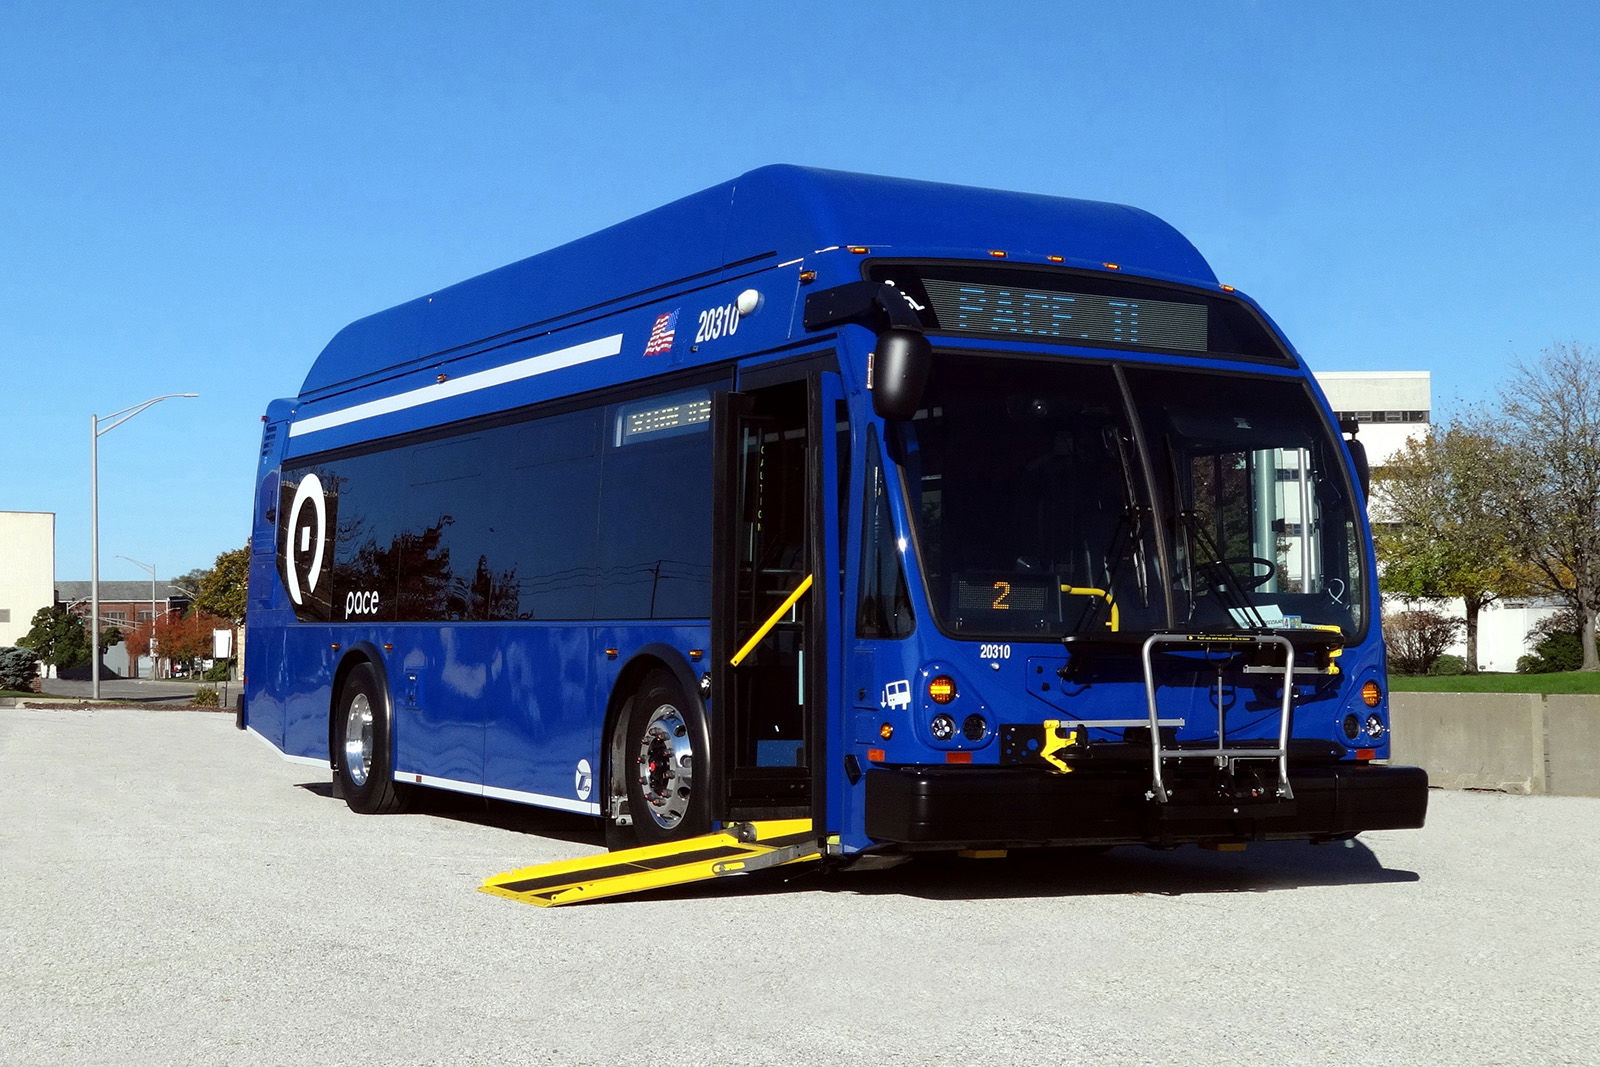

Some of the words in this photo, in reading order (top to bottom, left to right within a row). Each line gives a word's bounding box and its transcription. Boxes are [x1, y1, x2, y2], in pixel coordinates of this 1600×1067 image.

[695, 303, 740, 344] 20310
[344, 590, 380, 620] pace
[991, 580, 1011, 610] 2
[979, 643, 1011, 660] 20310
